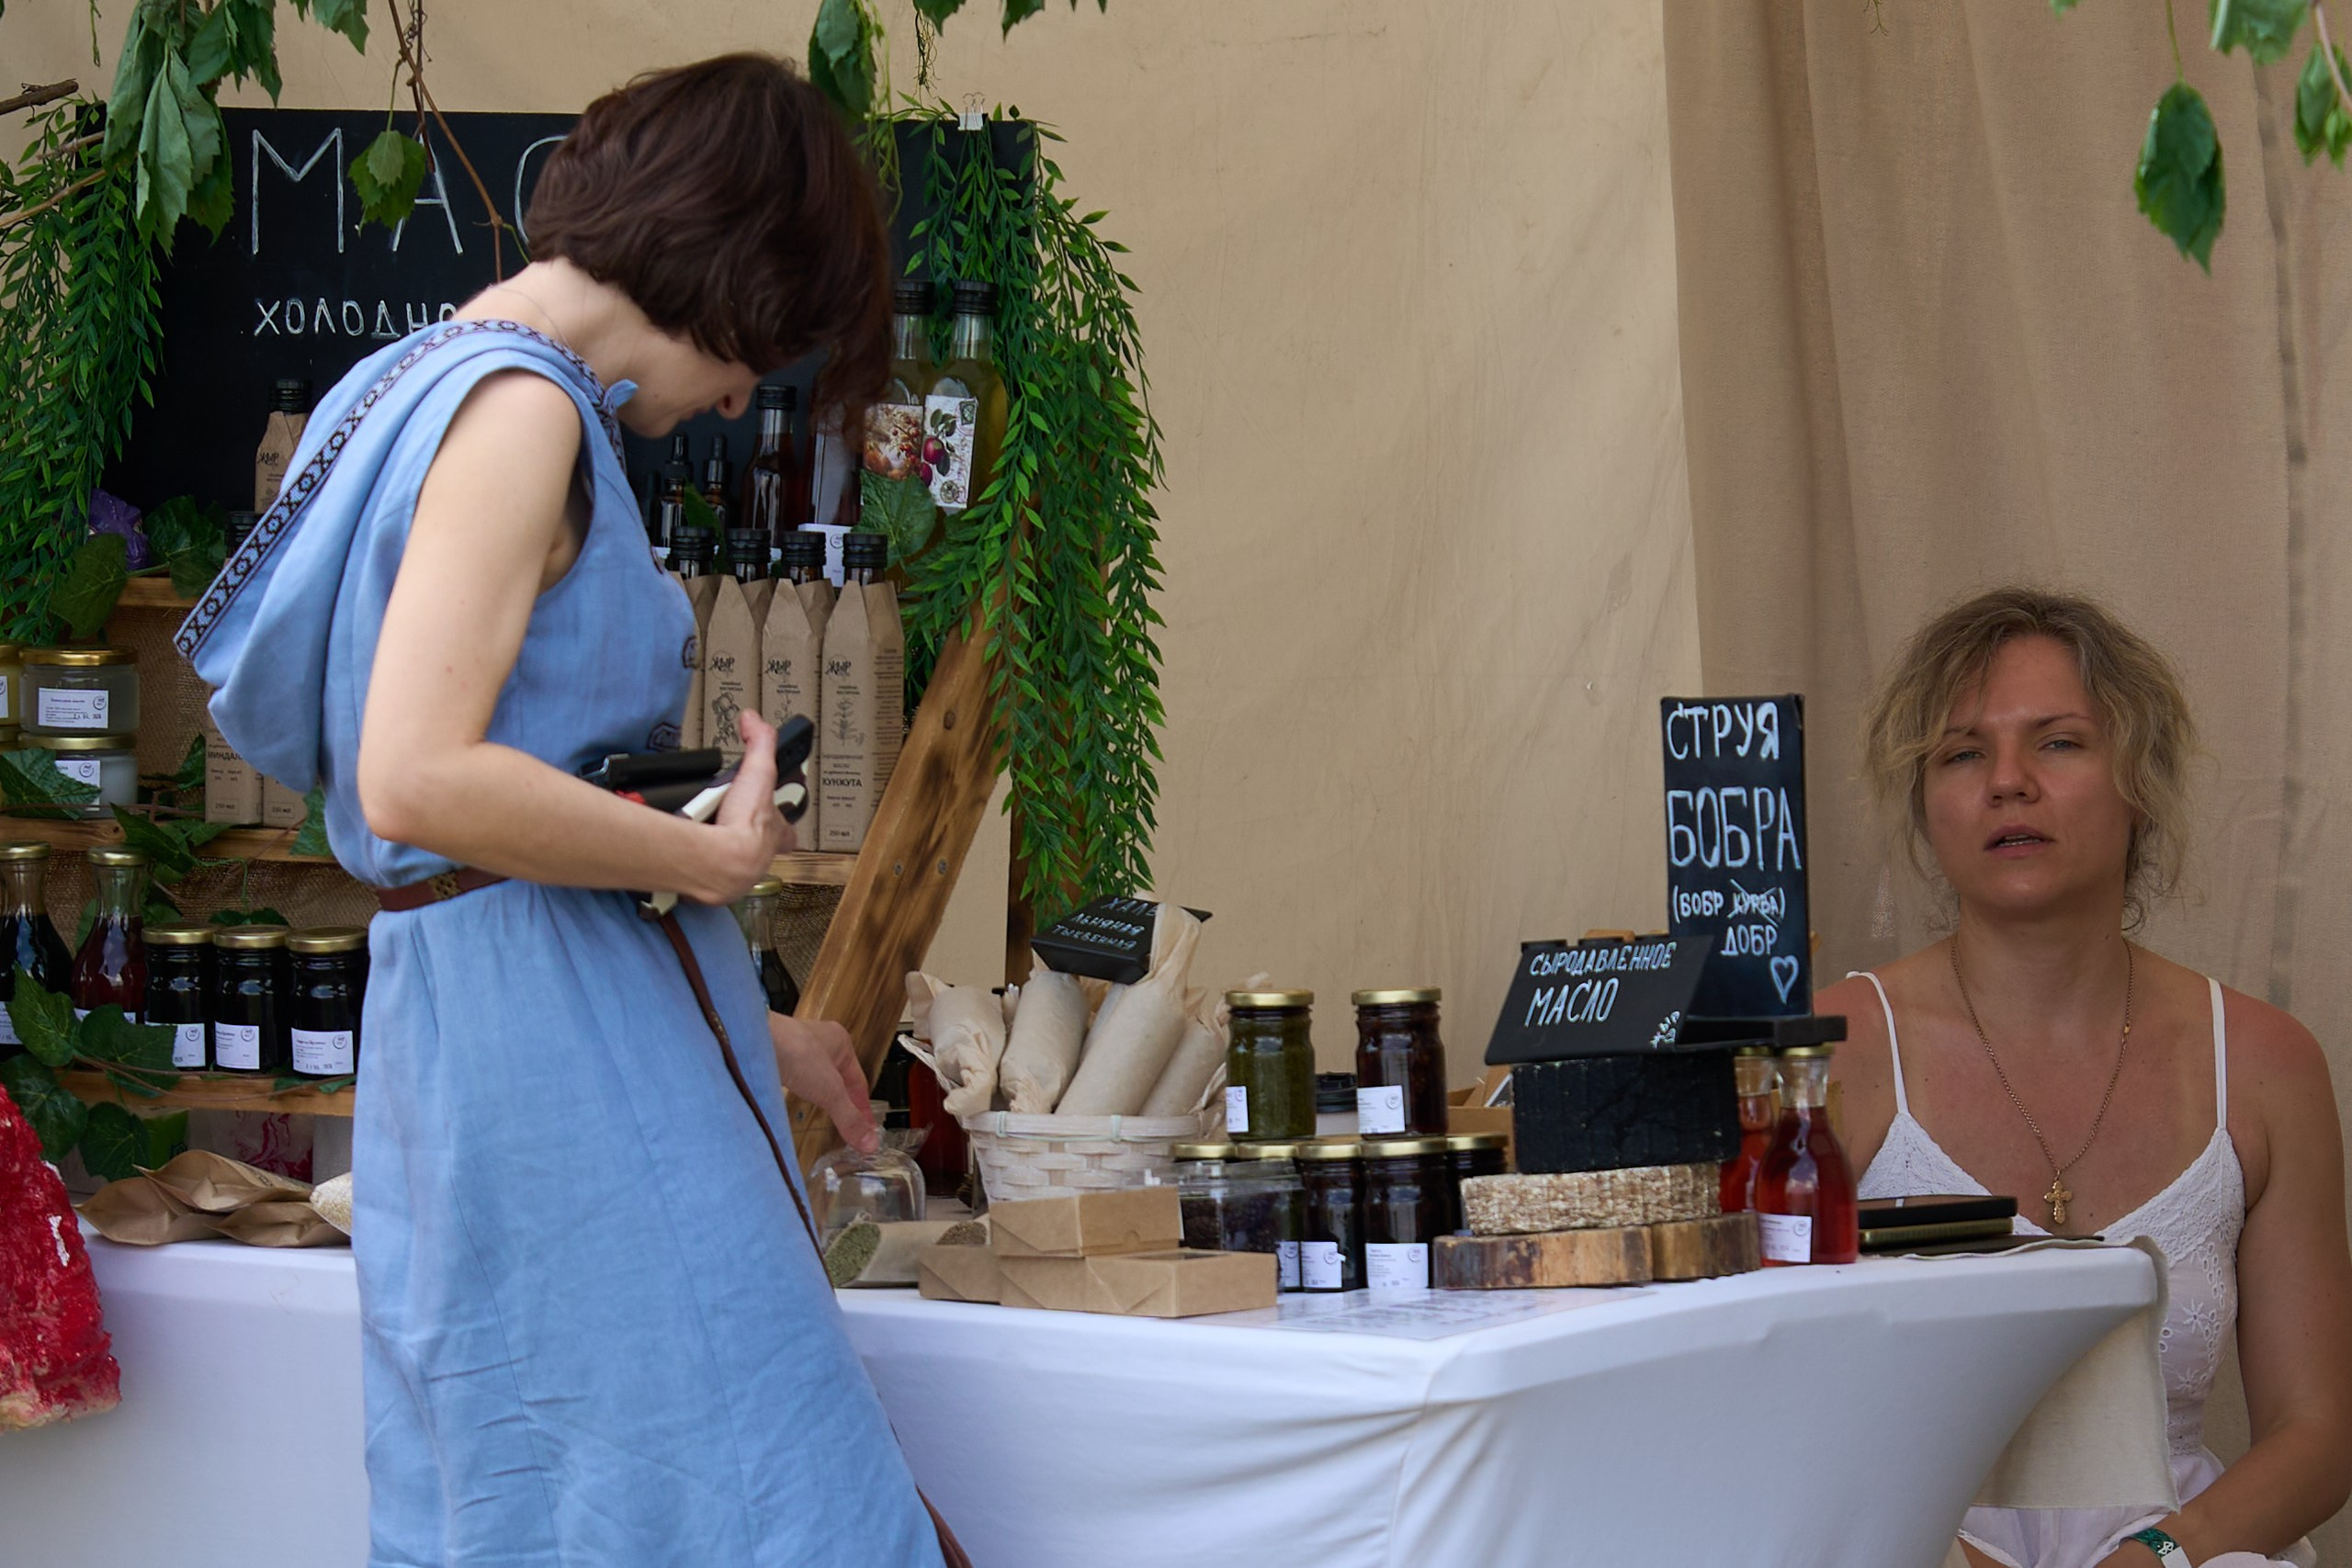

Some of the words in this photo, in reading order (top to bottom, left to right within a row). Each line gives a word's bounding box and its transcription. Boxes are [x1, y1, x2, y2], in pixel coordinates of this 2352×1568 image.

[251, 126, 570, 254] МАС
[253, 298, 457, 339] ХОЛОДНО
[1666, 701, 1781, 761] СТРУЯ
[207, 750, 243, 761] МИНДАЛ
[1666, 785, 1804, 872] БОБРА
[1069, 912, 1146, 936] ЛЬНЯНАЯ
[1100, 897, 1157, 917] ХАЛВ
[1051, 924, 1137, 951] ТЫКВЕННАЯ
[1720, 923, 1779, 957] ДОБР
[1529, 941, 1678, 977] СЫРОДАВЛЕННОЕ
[1523, 976, 1620, 1028] МАСЛО
